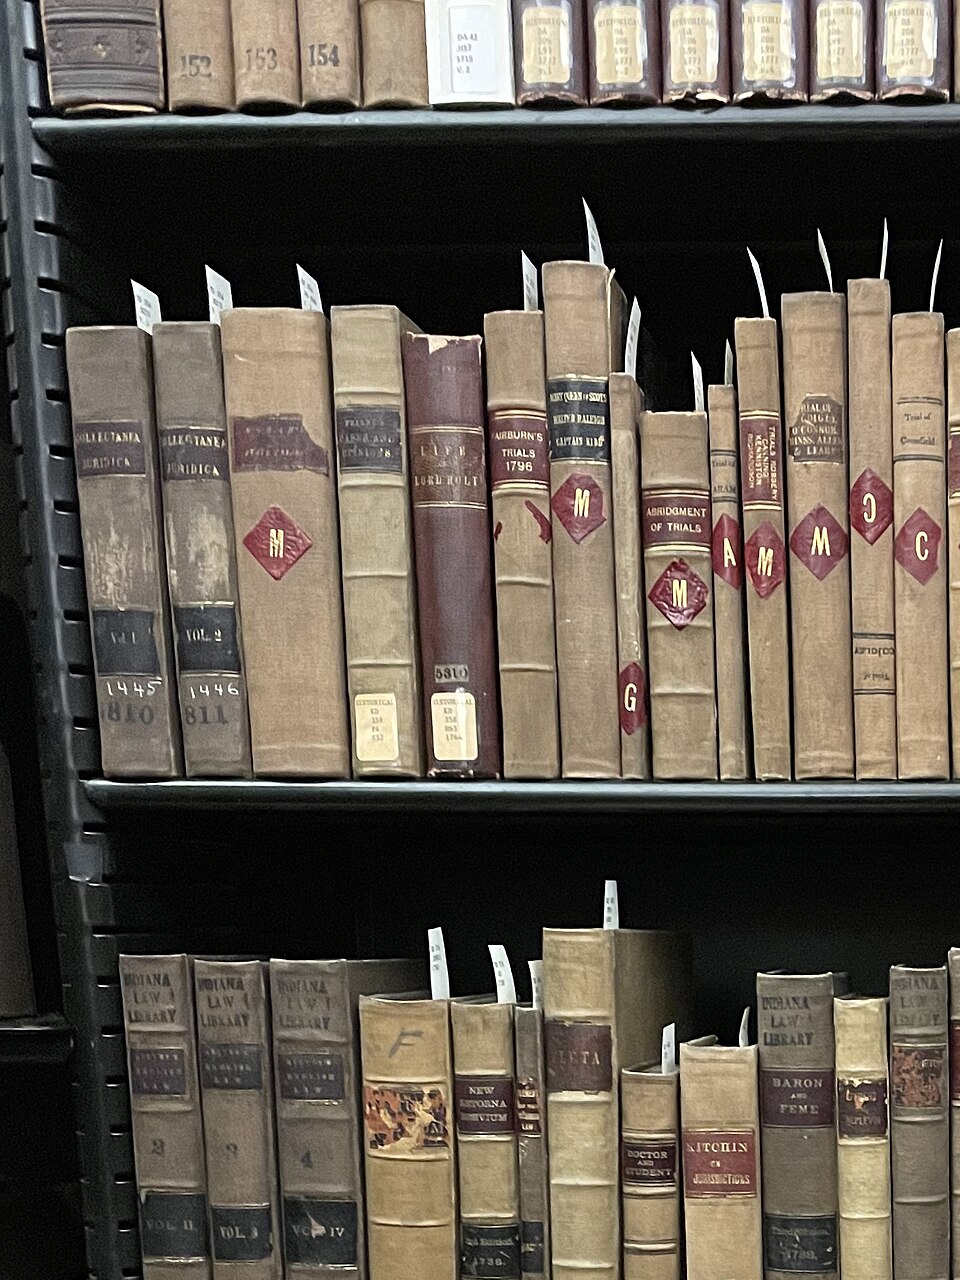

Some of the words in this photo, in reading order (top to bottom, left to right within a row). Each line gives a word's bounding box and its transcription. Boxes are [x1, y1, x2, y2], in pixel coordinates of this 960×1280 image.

[246, 49, 278, 71] 153
[309, 44, 340, 67] 154
[181, 55, 212, 77] 152
[905, 413, 922, 424] Trial
[924, 413, 931, 423] of
[769, 426, 777, 456] TRIALS
[502, 448, 535, 458] TRIALS
[506, 461, 533, 471] 1796
[447, 477, 478, 487] HOLT
[574, 488, 590, 517] M
[863, 493, 876, 522] C
[646, 506, 706, 518] ABRIDGMENT
[650, 523, 662, 531] OF
[667, 522, 702, 533] TRIALS
[270, 528, 285, 558] H
[811, 526, 831, 556] M
[916, 531, 928, 560] C
[723, 538, 736, 567] A
[757, 547, 773, 576] M
[671, 579, 688, 607] M
[215, 629, 222, 641] 2
[107, 681, 161, 697] 1445
[190, 682, 239, 698] 1446
[624, 682, 637, 713] G
[108, 702, 154, 724] 810
[186, 705, 228, 724] 811
[207, 995, 234, 1008] LAW
[129, 1009, 177, 1023] LIBRARY
[201, 1014, 250, 1028] LIBRARY
[763, 1032, 813, 1046] LIBRARY
[773, 1078, 822, 1088] BARON
[469, 1087, 494, 1097] NEW
[780, 1104, 818, 1115] FEME
[628, 1150, 668, 1160] DOCTOR
[626, 1167, 671, 1178] STUDENT
[693, 1174, 750, 1185] JURISDICTIONS
